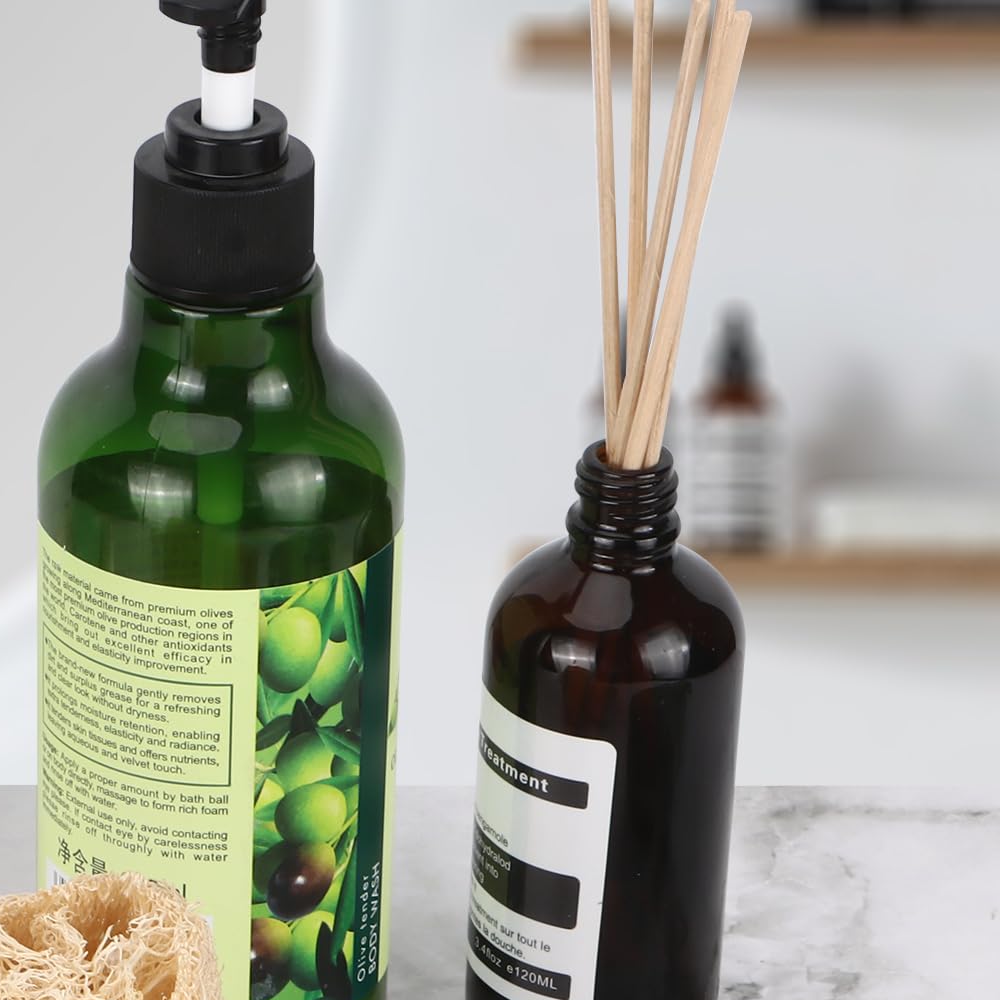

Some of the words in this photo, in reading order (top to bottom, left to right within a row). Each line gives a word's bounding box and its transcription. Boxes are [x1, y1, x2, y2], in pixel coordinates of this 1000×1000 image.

[63, 569, 92, 592] material
[93, 587, 119, 602] came
[121, 595, 145, 609] from
[147, 603, 197, 617] premium
[199, 608, 234, 619] olives
[63, 581, 82, 600] along
[84, 592, 153, 622] Mediterranean
[157, 616, 191, 629] coast,
[195, 621, 218, 630] one
[221, 619, 234, 630] of
[60, 610, 80, 633] bring
[83, 628, 98, 641] out
[104, 637, 155, 658] excellent
[162, 651, 213, 666] efficacy
[220, 654, 233, 664] in
[63, 592, 96, 616] premium
[96, 608, 118, 625] olive
[120, 619, 175, 638] production
[177, 630, 220, 642] regions
[222, 631, 233, 641] in
[69, 606, 106, 632] Carotene
[109, 627, 127, 639] and
[131, 634, 159, 646] other
[162, 640, 233, 653] antioxidants
[75, 634, 91, 648] and
[91, 643, 132, 665] elasticity
[133, 655, 208, 675] improvement.
[69, 671, 98, 692] surplus
[99, 687, 133, 705] grease
[135, 695, 150, 708] for
[153, 702, 160, 710] a
[163, 703, 221, 718] refreshing
[74, 683, 90, 700] look
[91, 694, 123, 713] without
[125, 706, 170, 723] dryness.
[98, 672, 133, 693] formula
[136, 687, 169, 702] gently
[172, 693, 222, 705] removes
[80, 701, 117, 724] moisture
[171, 730, 221, 743] enabling
[104, 724, 144, 744] elasticity
[146, 737, 167, 747] and
[66, 730, 99, 753] aqueous
[101, 748, 118, 761] and
[120, 755, 150, 769] velvet
[153, 762, 186, 775] touch.
[88, 731, 118, 750] tissues
[119, 744, 137, 755] and
[139, 748, 168, 762] offers
[170, 755, 220, 767] nutrients,
[479, 733, 550, 794] Treatment
[60, 751, 80, 772] Apply
[81, 767, 87, 775] a
[89, 771, 118, 788] proper
[120, 783, 159, 799] amount
[163, 791, 176, 804] by
[180, 793, 205, 804] bath
[208, 794, 229, 805] ball
[74, 785, 90, 799] with
[91, 794, 118, 811] water.
[96, 784, 138, 806] massage
[140, 798, 150, 808] to
[152, 800, 176, 813] form
[178, 805, 198, 815] rich
[200, 806, 229, 816] foam
[65, 790, 96, 815] External
[97, 810, 114, 823] use
[115, 816, 138, 832] only,
[140, 824, 169, 837] avoid
[171, 829, 229, 843] contacting
[81, 813, 113, 833] contact
[115, 828, 134, 841] eye
[137, 832, 151, 846] by
[153, 837, 229, 852] carelessness
[85, 825, 98, 838] off
[102, 832, 154, 858] throughly
[160, 848, 186, 861] with
[192, 852, 229, 863] water
[370, 861, 380, 919] WASH
[356, 935, 367, 983] Olive
[368, 923, 378, 975] BODY
[490, 931, 526, 960] douche.
[500, 924, 515, 939] sur
[517, 931, 538, 949] tout
[540, 941, 551, 953] le
